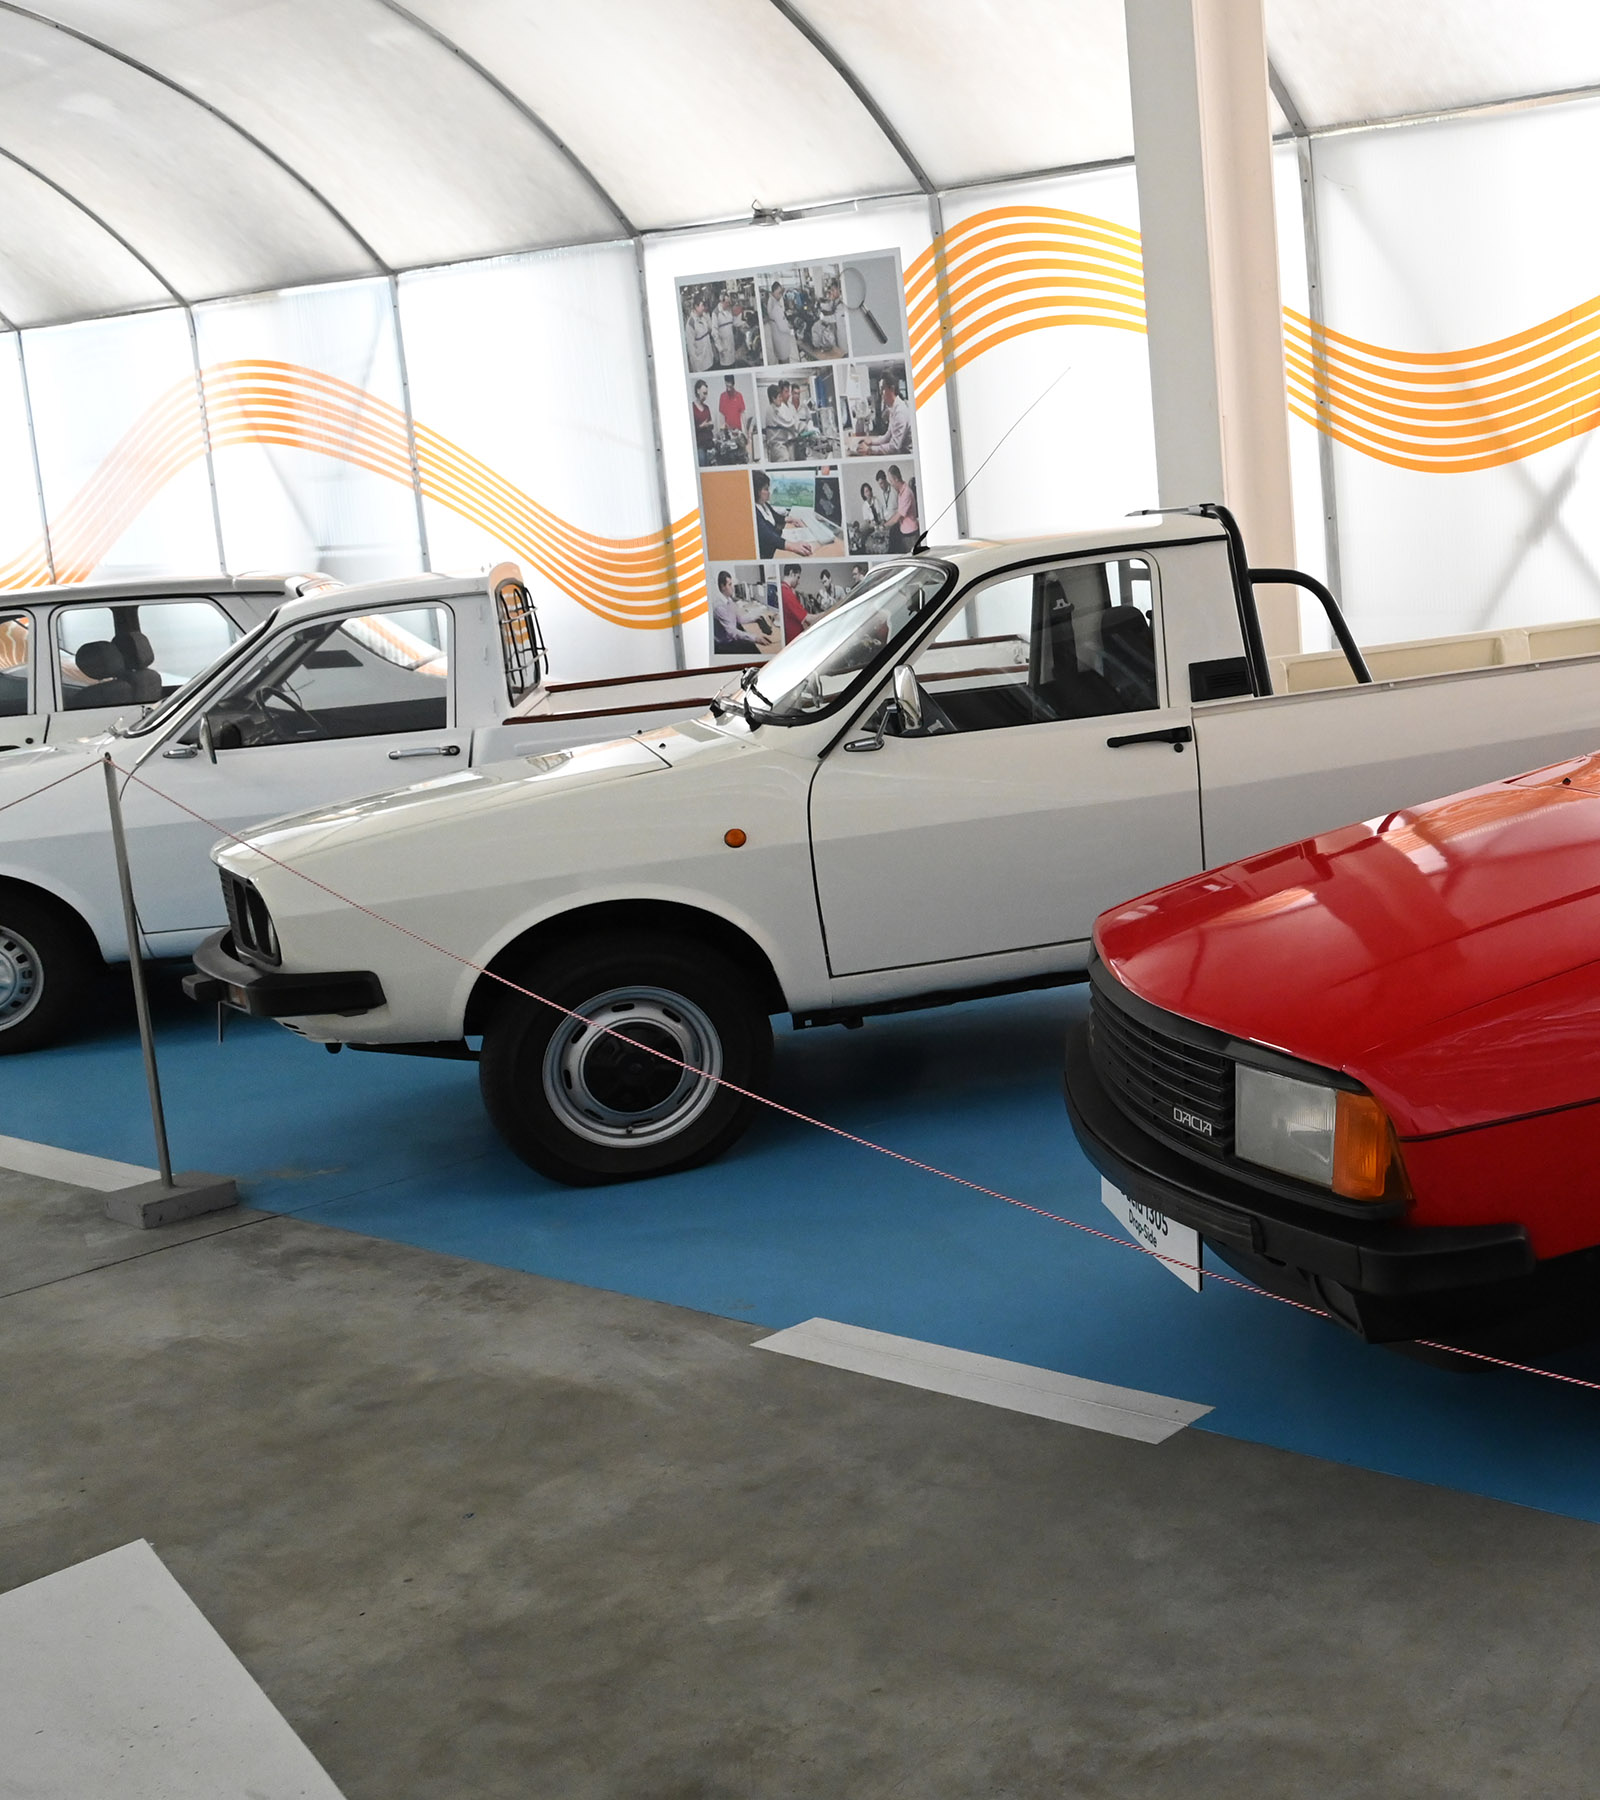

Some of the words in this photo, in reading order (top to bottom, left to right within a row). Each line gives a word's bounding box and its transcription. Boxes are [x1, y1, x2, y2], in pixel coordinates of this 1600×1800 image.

[1173, 1107, 1212, 1136] DACIA
[1129, 1208, 1158, 1248] Drop-Side
[1146, 1207, 1168, 1236] 1305
